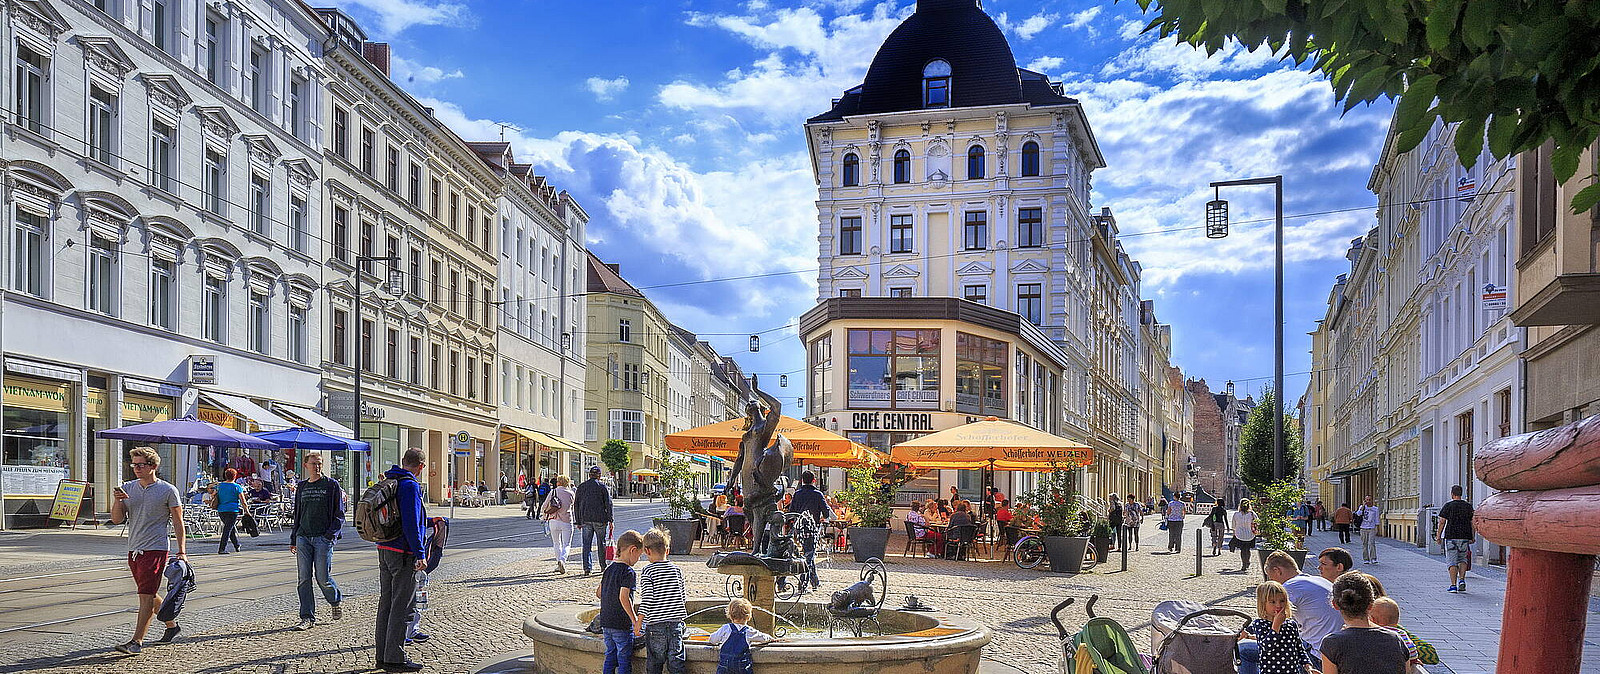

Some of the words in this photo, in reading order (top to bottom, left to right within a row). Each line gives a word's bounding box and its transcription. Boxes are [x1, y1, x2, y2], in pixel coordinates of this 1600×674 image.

[3, 385, 65, 401] VIETNAM-WOK
[912, 390, 937, 400] CENTRAL
[123, 402, 169, 415] VIETNAM-WOK
[360, 400, 386, 419] elmann
[852, 412, 879, 429] CAFÉ
[883, 413, 934, 430] CENTRAL
[1047, 450, 1088, 458] WEIZEN
